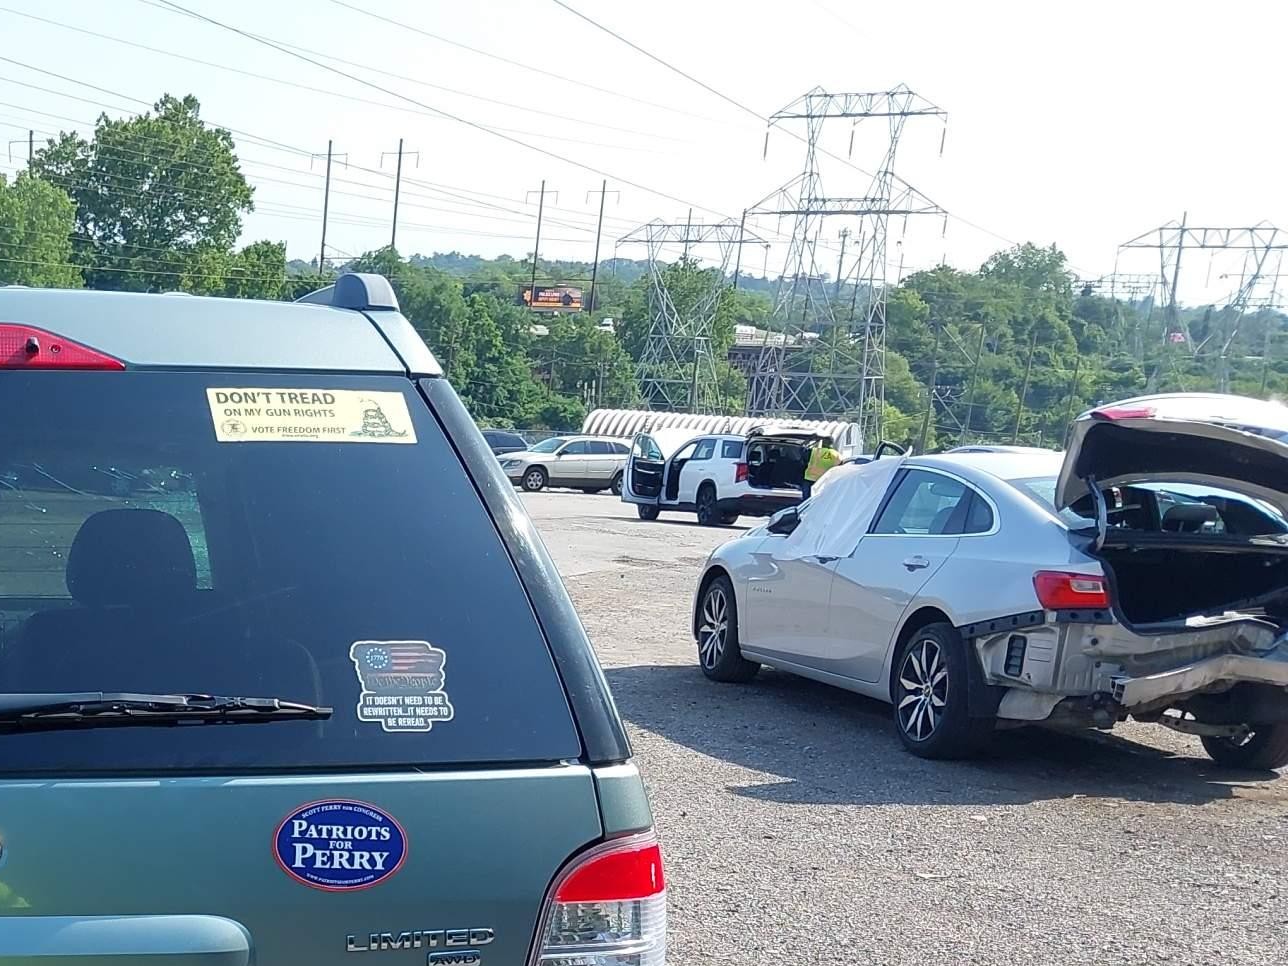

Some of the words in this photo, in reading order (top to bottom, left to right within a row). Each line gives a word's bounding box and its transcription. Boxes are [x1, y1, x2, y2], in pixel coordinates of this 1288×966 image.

[215, 391, 271, 404] DON'T
[274, 392, 336, 405] TREAD
[224, 408, 242, 416] ON
[244, 408, 262, 416] MY
[266, 408, 292, 417] GUN
[294, 408, 336, 418] RIGHTS
[251, 426, 275, 434] VOTE
[277, 426, 320, 434] FREEDOM
[322, 426, 346, 434] FIRST
[366, 696, 373, 705] IT
[374, 696, 404, 705] DOESN'T
[404, 696, 423, 705] NEED
[424, 696, 432, 705] TO
[434, 696, 443, 705] BE
[416, 706, 438, 716] NEEDS
[439, 706, 448, 716] TO
[388, 718, 397, 726] BE
[301, 806, 321, 819] SCOTT
[321, 804, 342, 812] PERRY
[291, 819, 390, 841] PATRIOTS
[328, 840, 353, 850] FOR
[292, 842, 390, 871] PERRY
[346, 928, 495, 952] LIMITED
[432, 955, 478, 966] AWD
